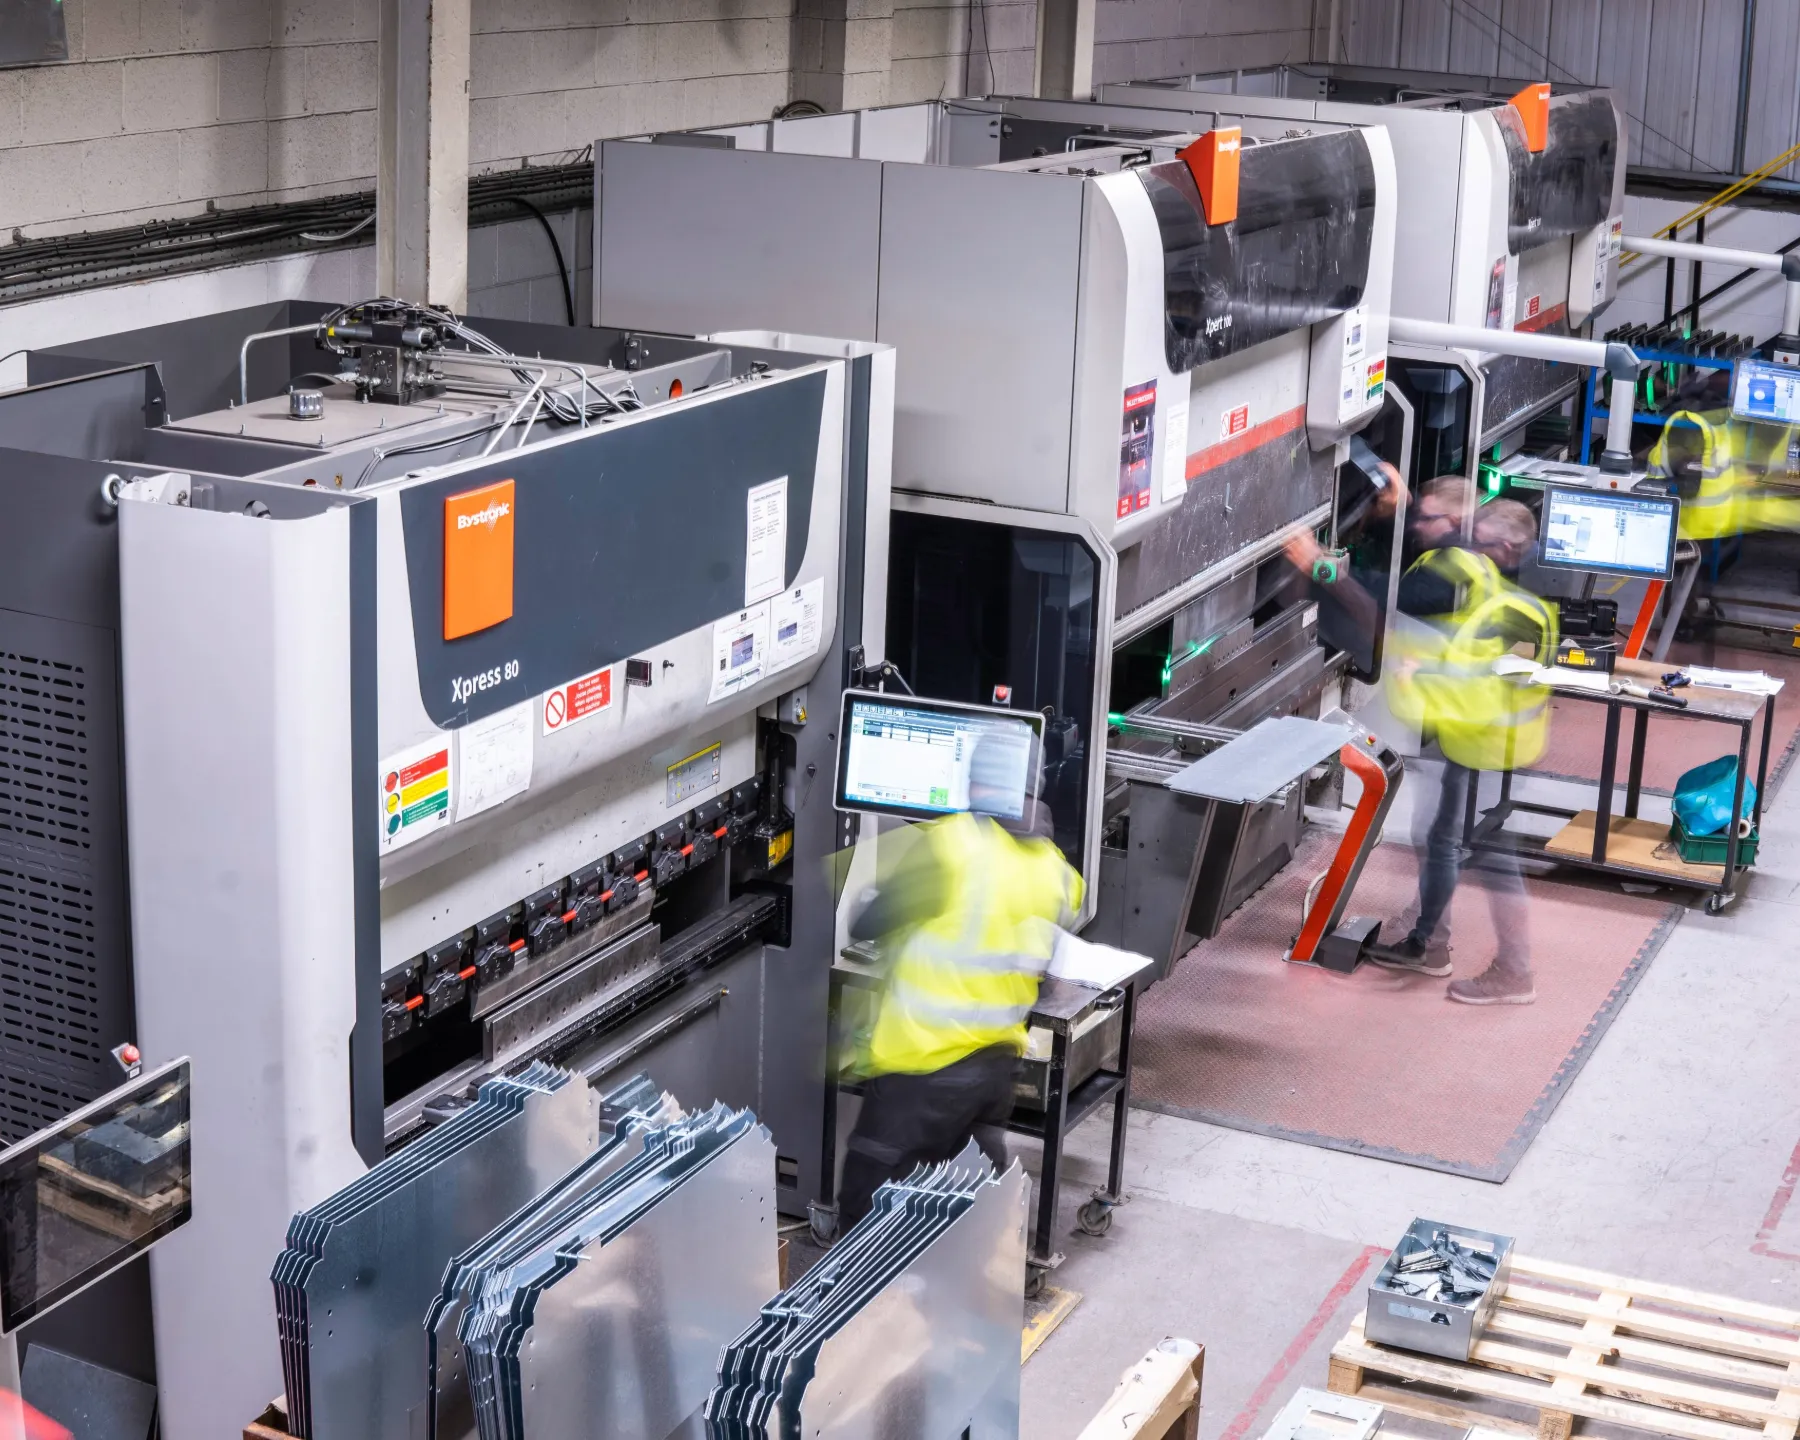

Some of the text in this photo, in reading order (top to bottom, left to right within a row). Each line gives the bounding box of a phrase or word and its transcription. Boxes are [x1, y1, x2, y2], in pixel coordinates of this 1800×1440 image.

[1206, 315, 1223, 337] Xpert
[1557, 656, 1596, 666] STEY
[451, 659, 519, 704] Xpress 80
